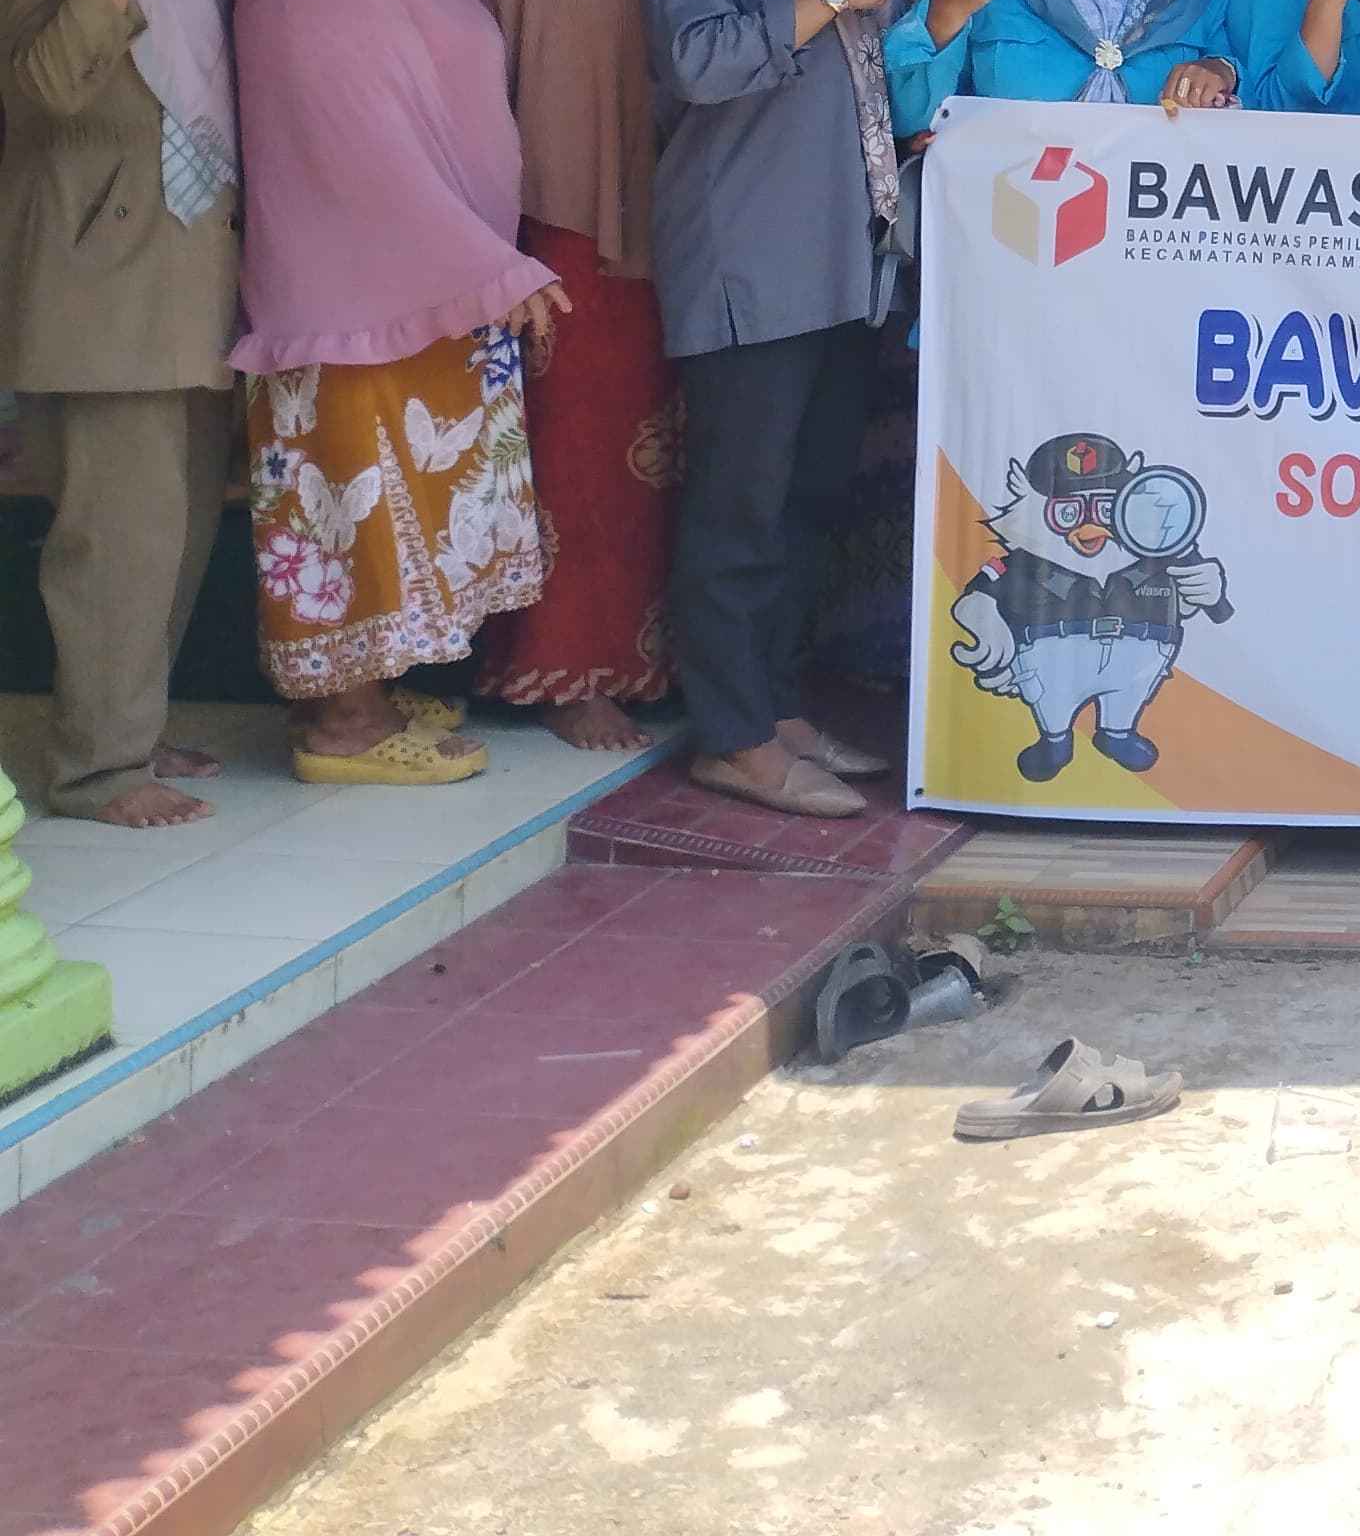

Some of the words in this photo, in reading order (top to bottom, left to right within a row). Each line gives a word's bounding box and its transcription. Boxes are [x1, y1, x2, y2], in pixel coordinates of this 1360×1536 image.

[1126, 229, 1191, 245] BADAN
[1198, 231, 1301, 249] PENGAWAS
[1125, 247, 1264, 265] KECAMATAN
